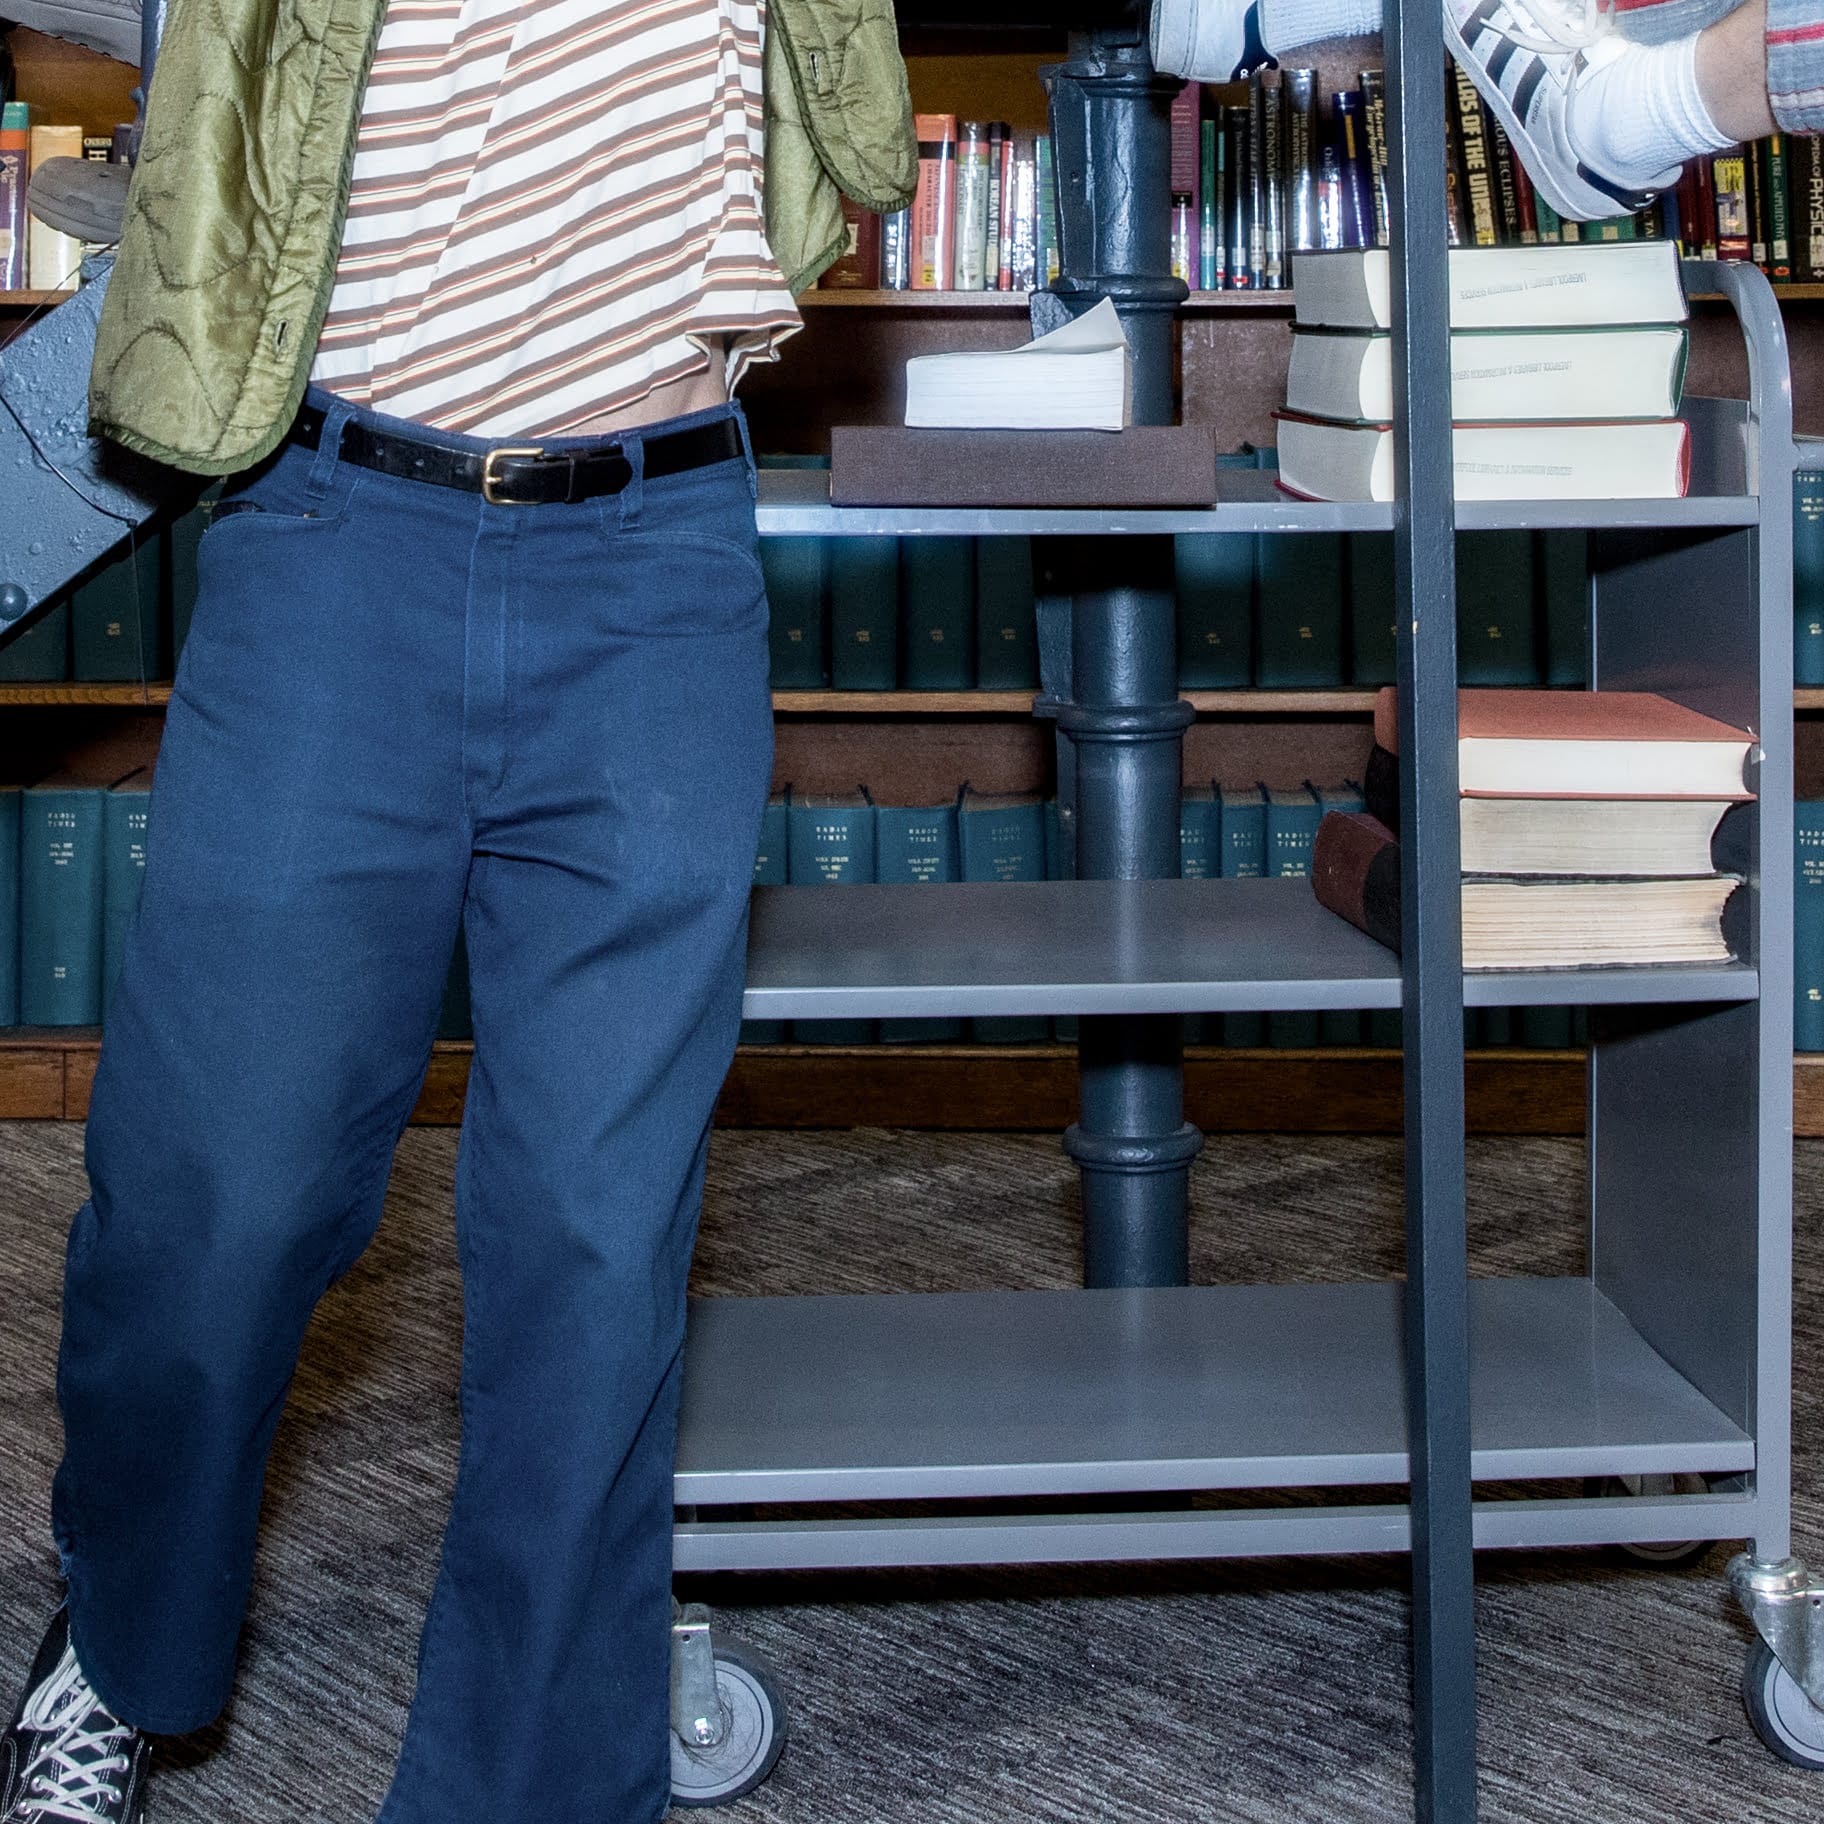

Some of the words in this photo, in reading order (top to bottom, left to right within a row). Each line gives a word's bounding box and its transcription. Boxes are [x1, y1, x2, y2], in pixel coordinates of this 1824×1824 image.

[1266, 98, 1278, 179] ASTRONOMY
[1463, 115, 1482, 135] OF
[1468, 137, 1485, 171] THE
[1811, 166, 1822, 177] OF
[989, 179, 1000, 218] KOREAN
[1499, 161, 1517, 224] ECLIPSES
[1773, 190, 1784, 222] APPLIED
[816, 834, 848, 842] TIMES
